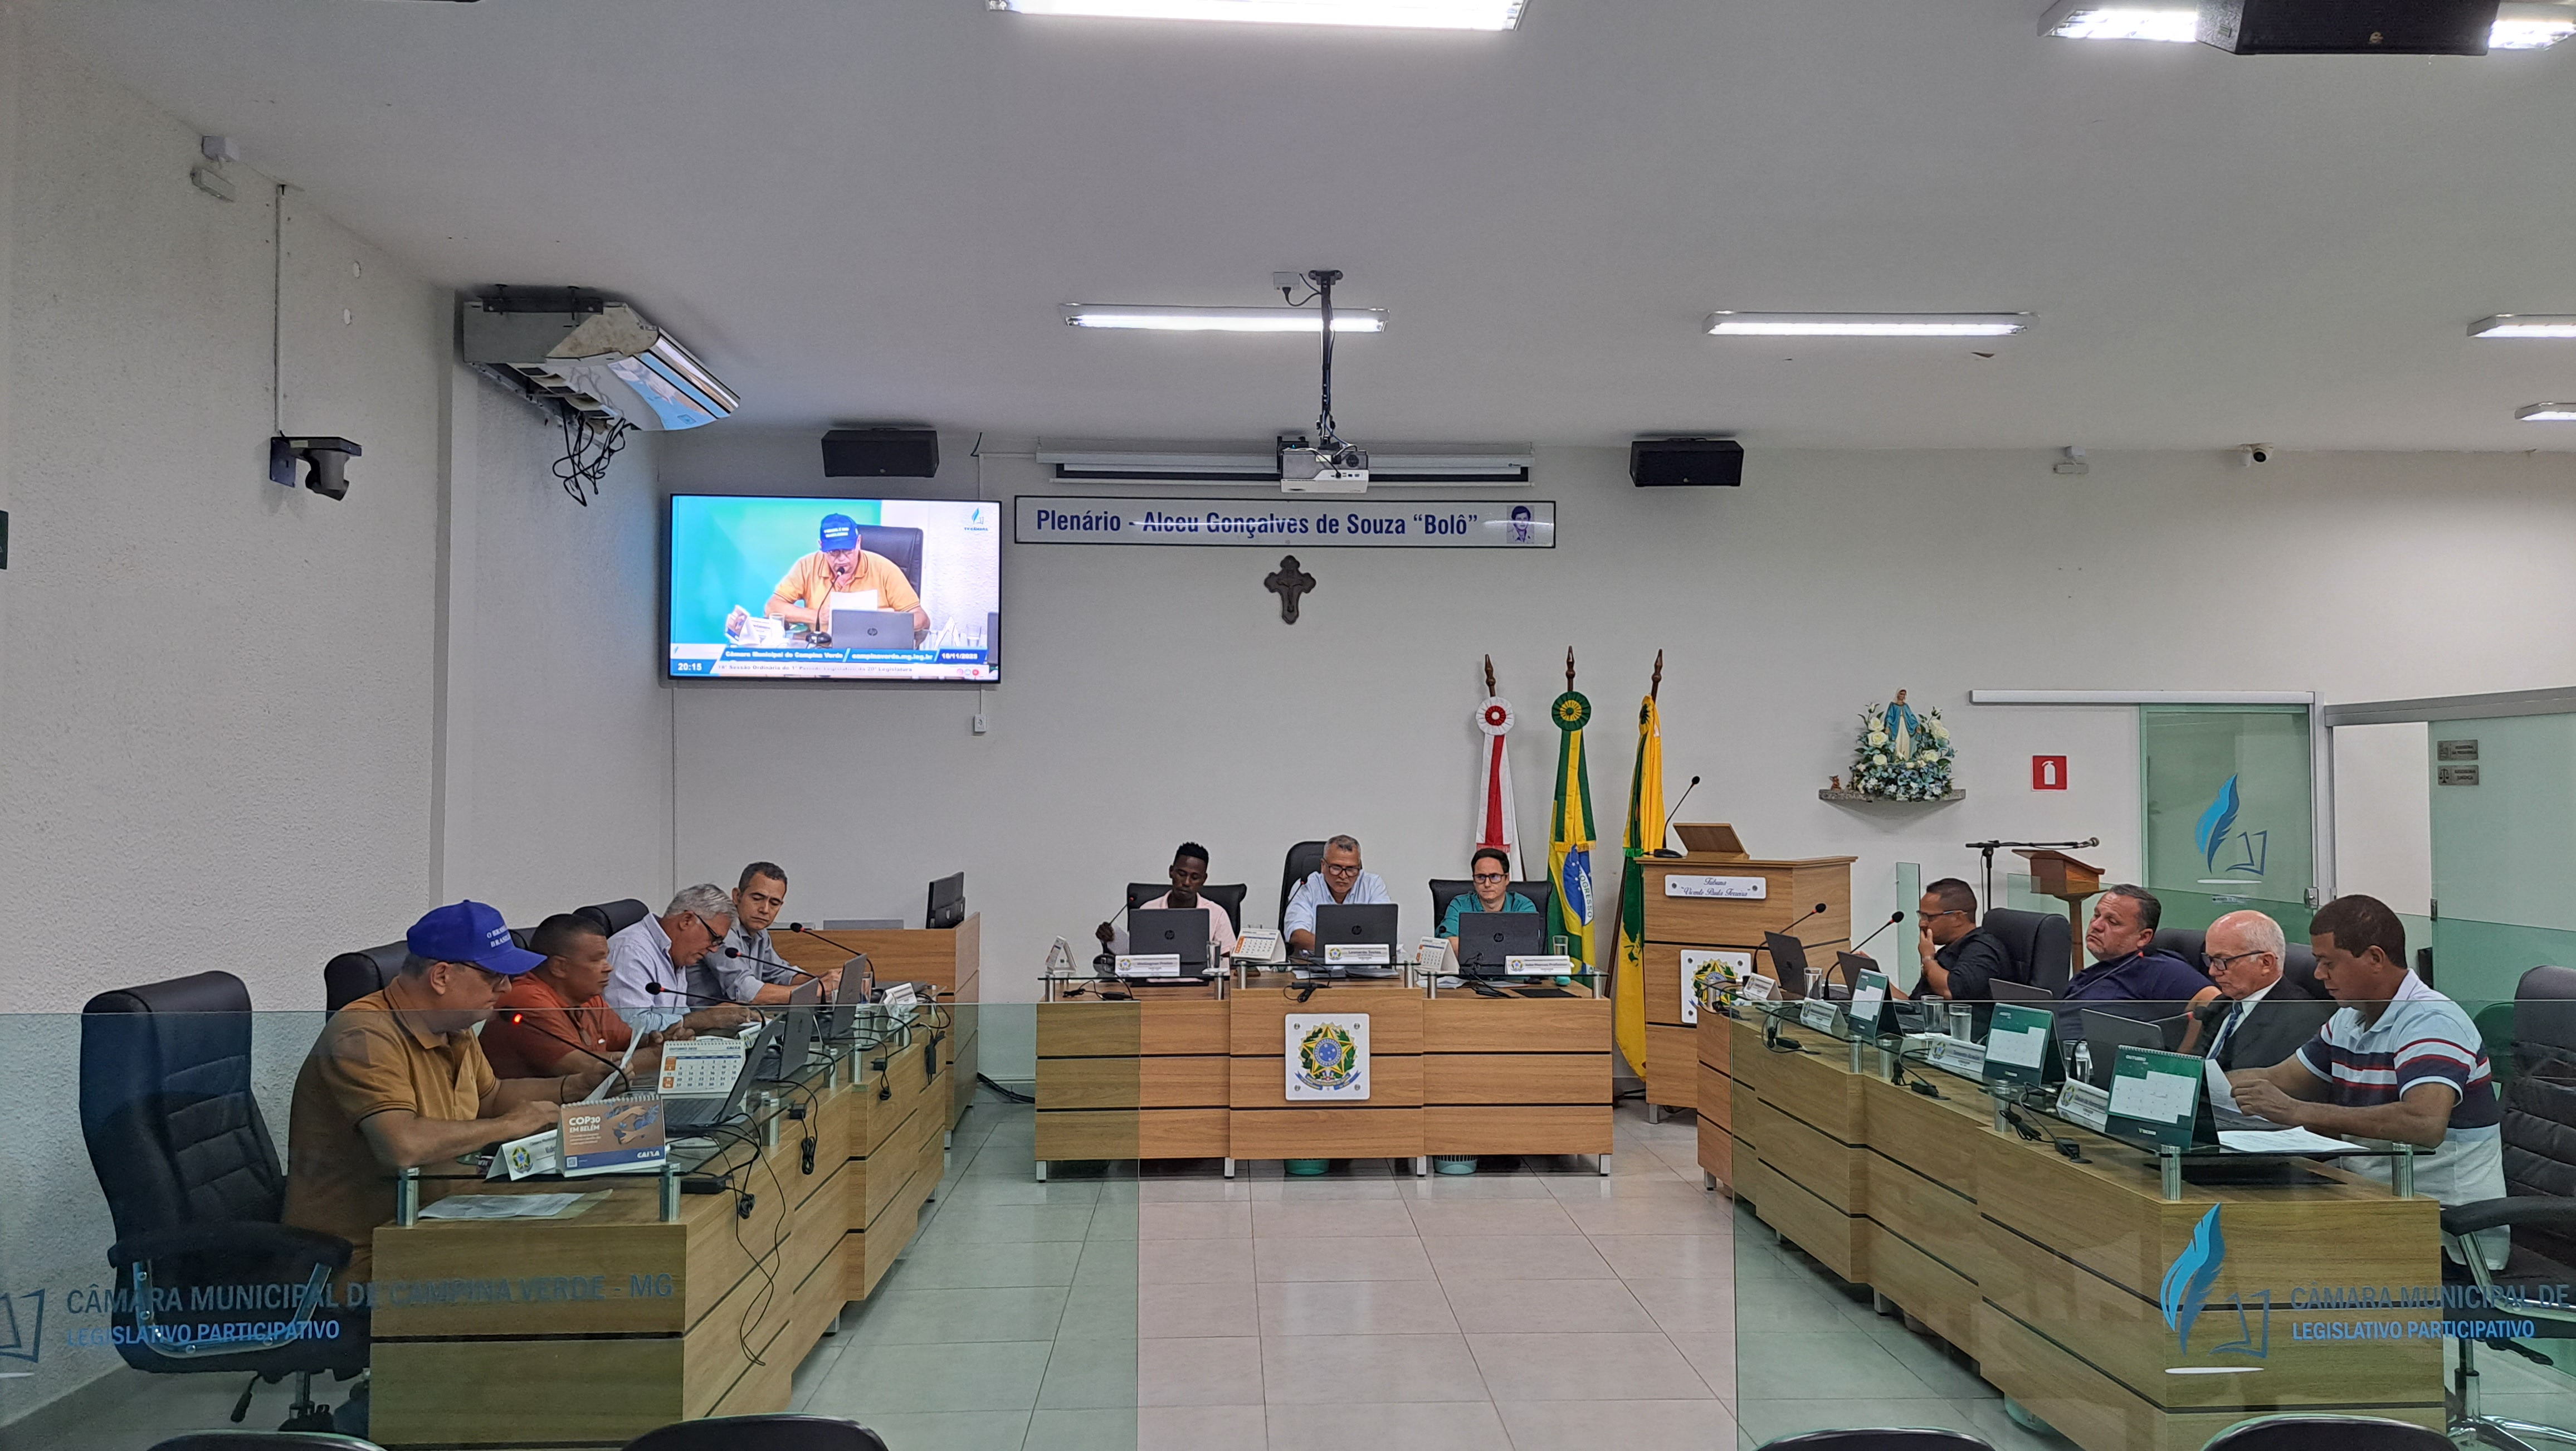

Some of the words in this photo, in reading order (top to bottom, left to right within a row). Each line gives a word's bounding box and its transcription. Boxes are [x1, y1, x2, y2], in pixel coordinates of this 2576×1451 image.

[1037, 509, 1121, 532] Plenário
[1143, 511, 1199, 533] Alceu
[1206, 512, 1309, 539] Gonçalves
[1316, 513, 1340, 534] de
[1346, 513, 1406, 535] Souza
[677, 663, 702, 671] 20:15
[568, 1116, 601, 1126] COP30
[580, 1124, 600, 1132] BELÉM
[637, 1150, 660, 1158] CAIXA
[66, 1283, 183, 1314] CÂMARA
[191, 1282, 339, 1311] MUNICIPAL
[517, 1274, 607, 1302] VERDE
[630, 1272, 674, 1299] MG
[2290, 1281, 2394, 1311] CÂMARA
[2400, 1284, 2533, 1310] MUNICIPAL
[2539, 1284, 2570, 1308] DE
[66, 1324, 192, 1346] LEGISLATIVO
[197, 1319, 340, 1342] PARTICIPATIVO
[2292, 1321, 2402, 1341] LEGISLATIVO
[2407, 1319, 2536, 1339] PARTICIPATIVO
